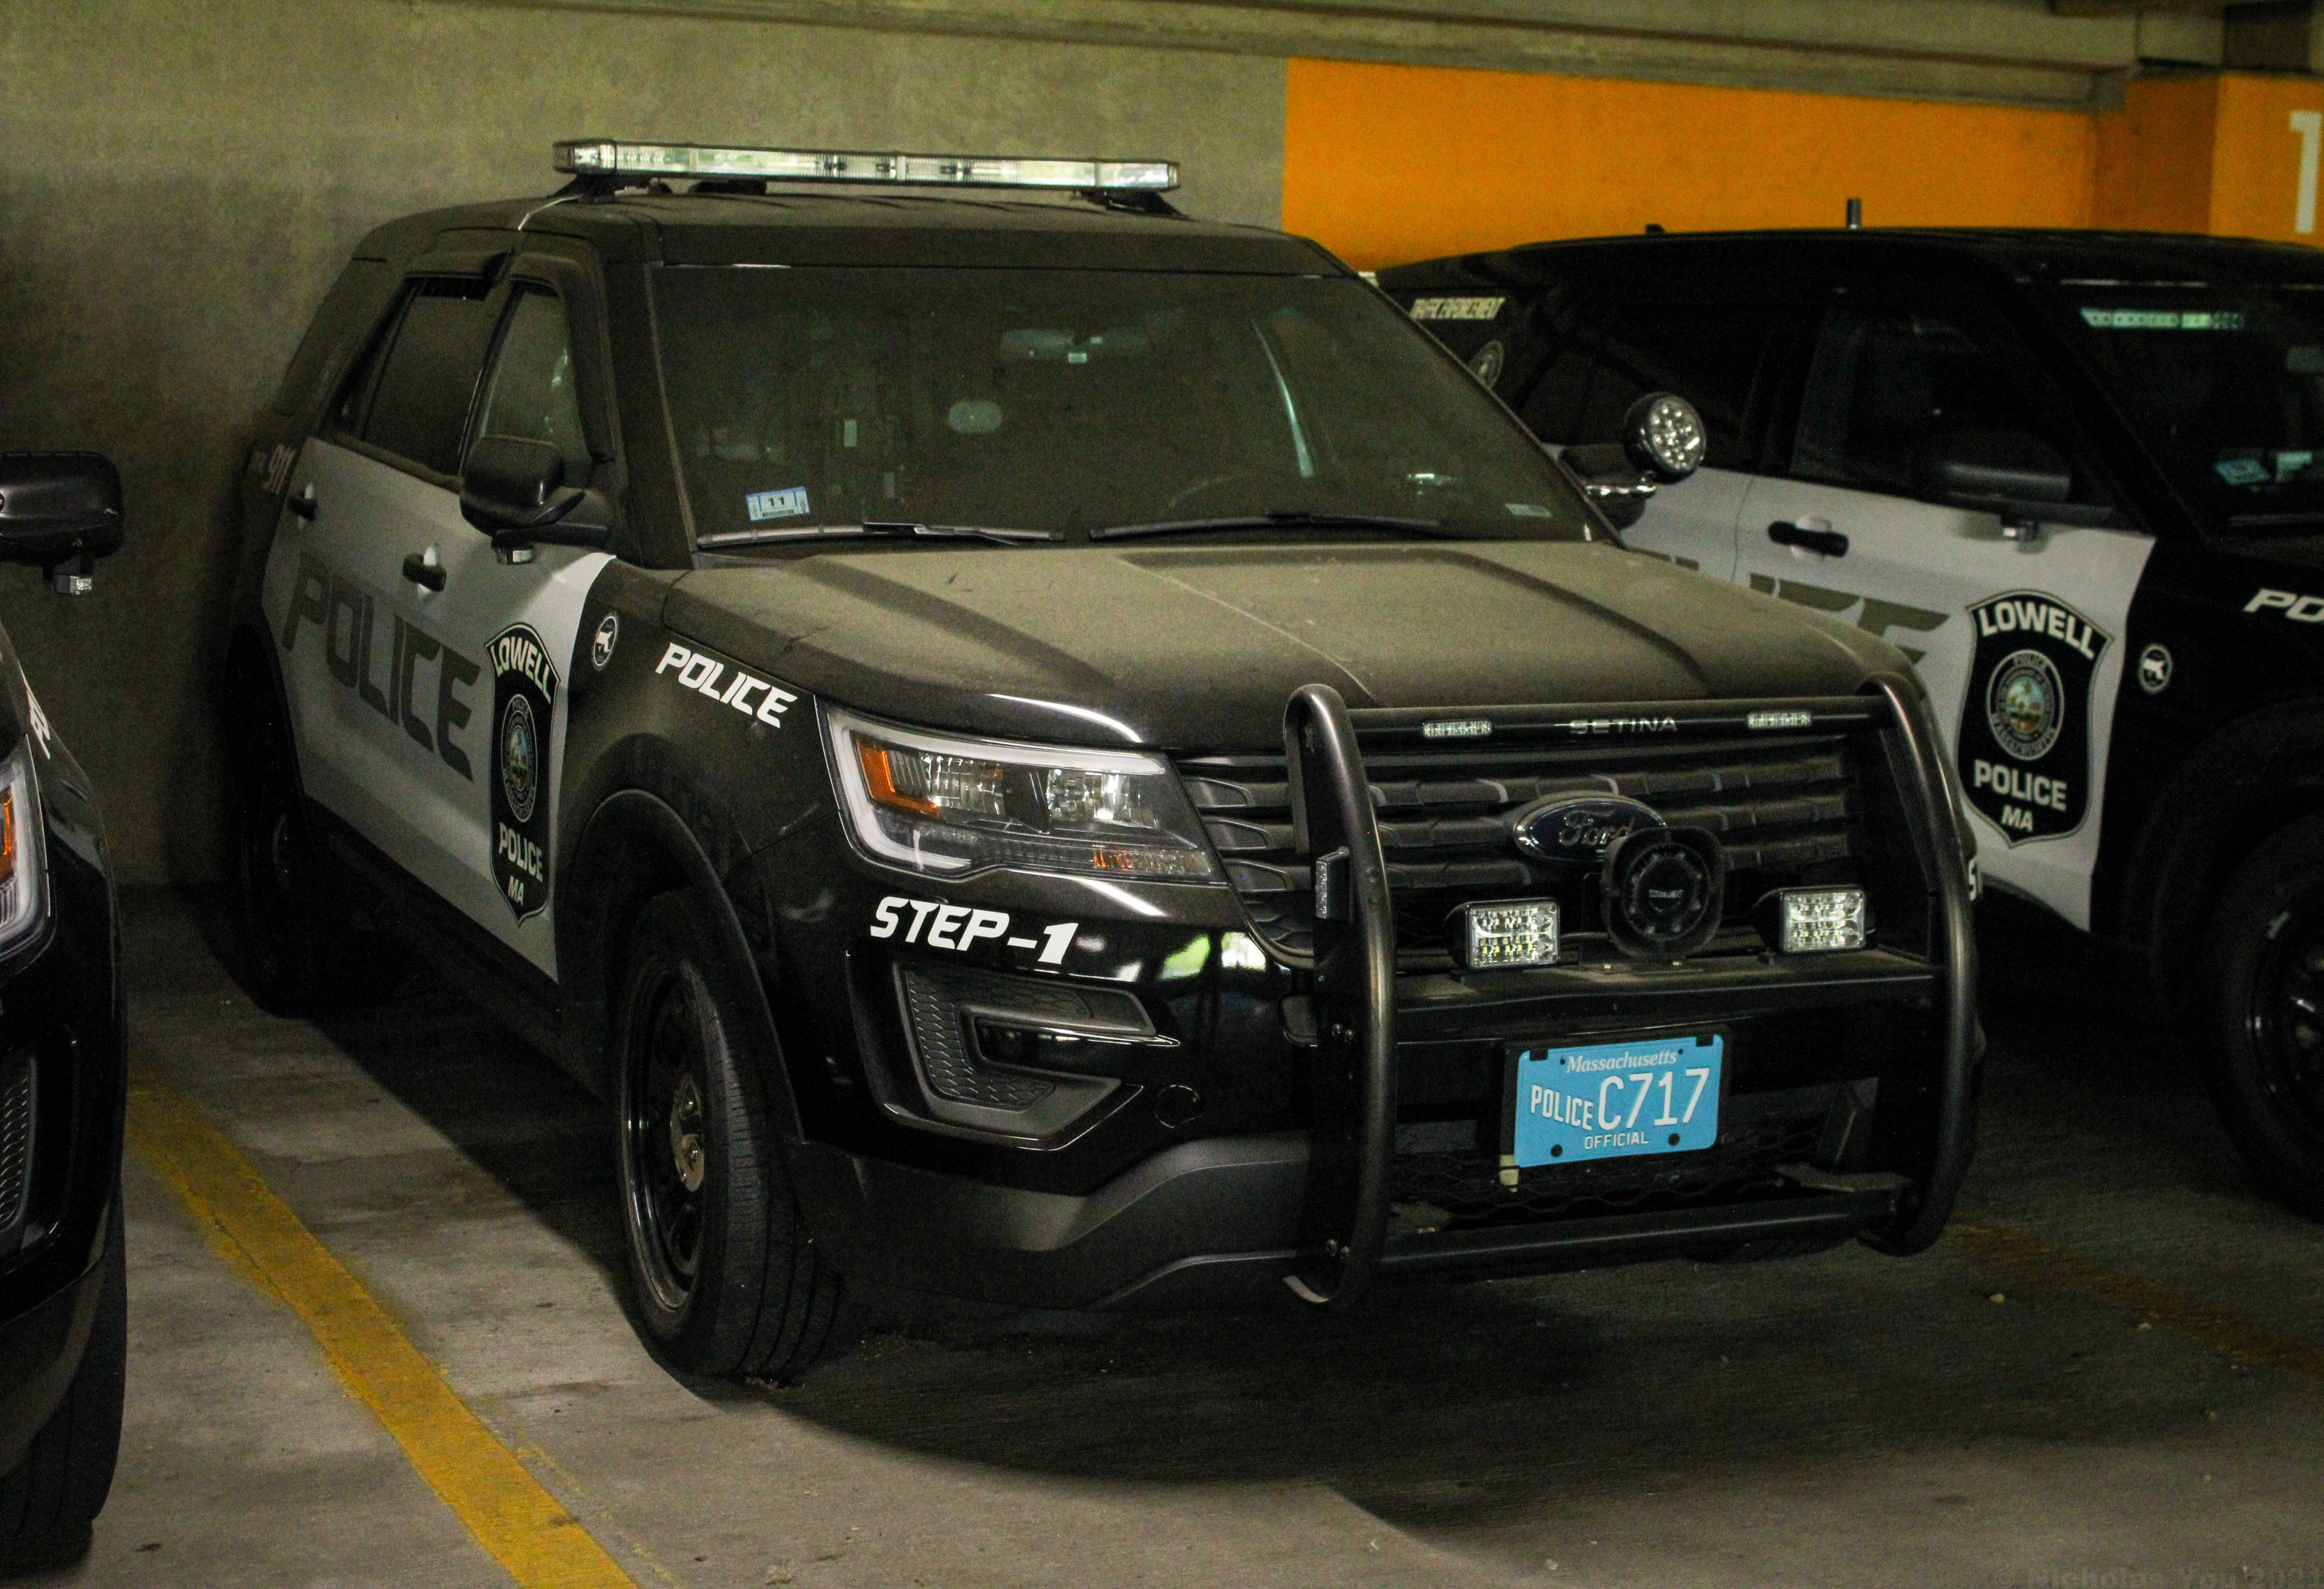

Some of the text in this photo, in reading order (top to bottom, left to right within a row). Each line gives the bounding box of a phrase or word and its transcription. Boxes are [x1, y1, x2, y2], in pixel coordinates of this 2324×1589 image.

[768, 497, 785, 507] 11
[1978, 601, 2095, 660] LOWELL
[283, 549, 482, 783] POLICE
[490, 636, 551, 704] LOWELL
[655, 642, 797, 729] POLICE
[1570, 717, 1678, 734] SETINA
[1973, 759, 2067, 812] POLICE
[2001, 805, 2032, 832] MA
[499, 822, 543, 882] POLICE
[508, 876, 524, 906] MA
[870, 897, 1079, 965] STEP-1
[1567, 1050, 1677, 1073] Massachusetts
[1531, 1067, 1710, 1131] POLICE C717
[1585, 1132, 1649, 1150] OFFICIAL
